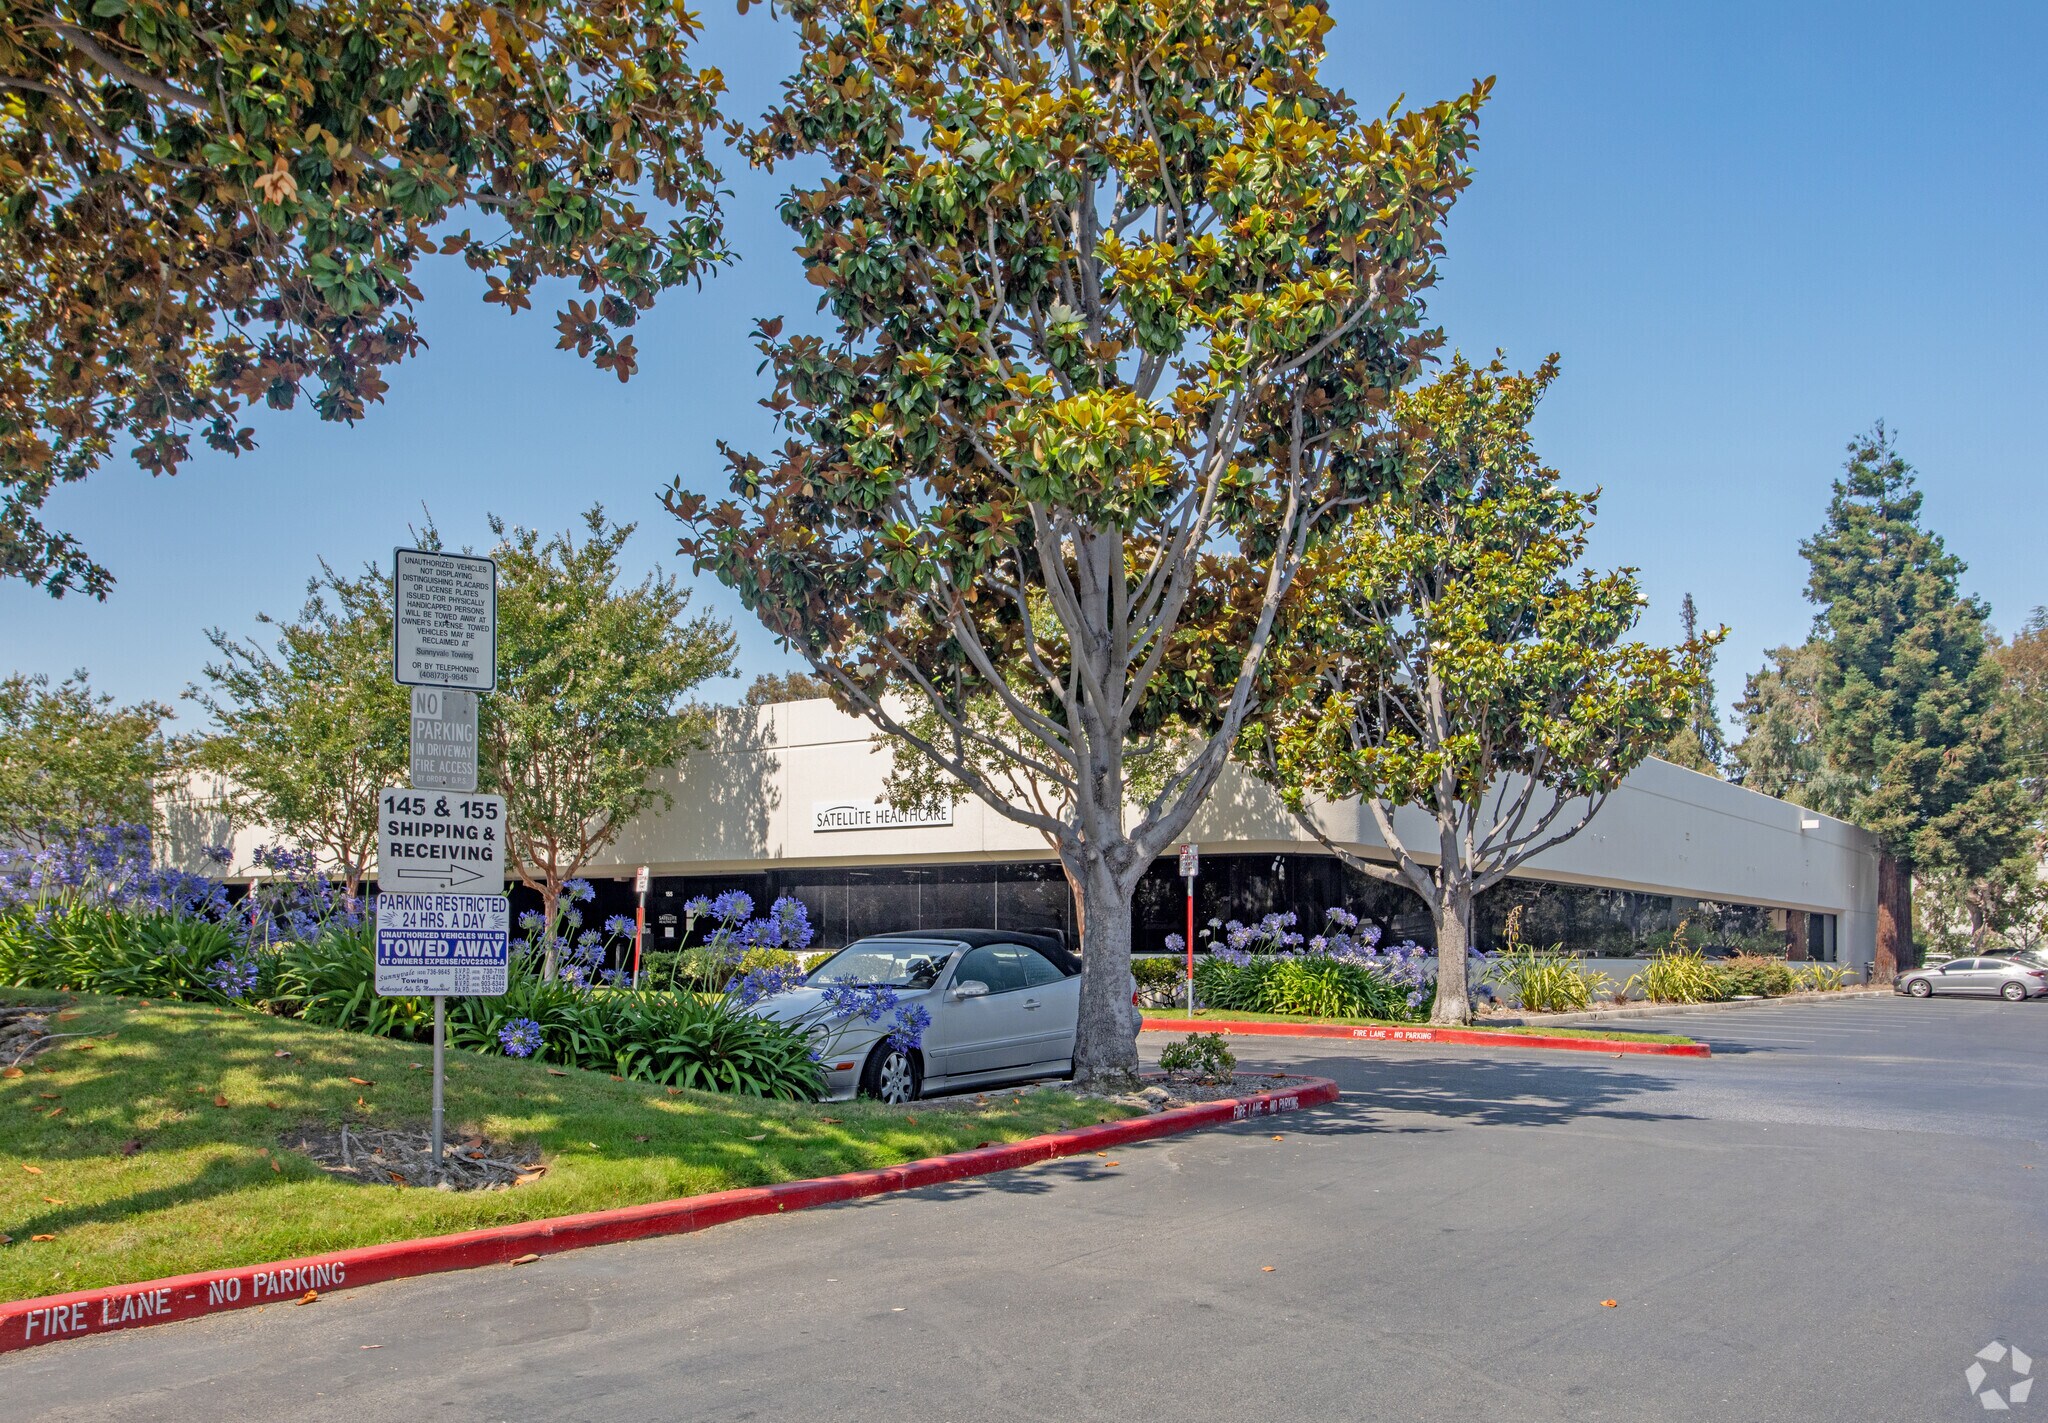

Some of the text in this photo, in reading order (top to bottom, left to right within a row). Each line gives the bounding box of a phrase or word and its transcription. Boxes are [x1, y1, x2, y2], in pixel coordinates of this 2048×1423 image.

[404, 557, 487, 573] UNAUTHORIZED VEHICLES
[403, 574, 489, 590] DISTINGUISHING PLACARDS
[436, 569, 472, 580] DISPLAYING
[426, 585, 452, 594] LICENSE
[456, 588, 478, 597] PLATES
[407, 592, 485, 606] ISSUED FOR PHYSICALLY
[405, 609, 420, 617] WILL
[435, 612, 457, 620] TOWED
[460, 614, 476, 622] AWAY
[407, 601, 484, 615] HANDICAPPED PERSONS
[402, 618, 432, 626] OWNER'S
[468, 624, 490, 632] TOWED
[417, 628, 448, 636] VEHICLES
[422, 637, 459, 646] RECLAIMED
[416, 648, 473, 660] Sunnyvale Towing
[436, 664, 479, 673] TELEPHONING
[417, 692, 438, 715] NO
[417, 720, 472, 742] PARKING
[416, 743, 472, 758] IN DRIVEWAY
[415, 759, 472, 775] FIRE ACCESS
[385, 796, 498, 820] 145 & 155
[388, 821, 496, 841] SHIPPING &
[391, 842, 493, 861] RECEIVING
[380, 895, 506, 912] PARKING RESTRICTED
[403, 912, 486, 928] 24 HRS. A DAY
[381, 931, 439, 939] UNAUTHORIZED
[382, 939, 504, 957] TOWED AWAY
[379, 969, 415, 982] Sunnyvale
[1370, 1030, 1386, 1038] LANE
[1270, 1099, 1277, 1112] NO
[1279, 1097, 1298, 1110] PARKING
[25, 1301, 88, 1340] FIRE
[103, 1287, 172, 1325] LANE
[209, 1277, 241, 1305] NO
[253, 1261, 346, 1298] PARKING
